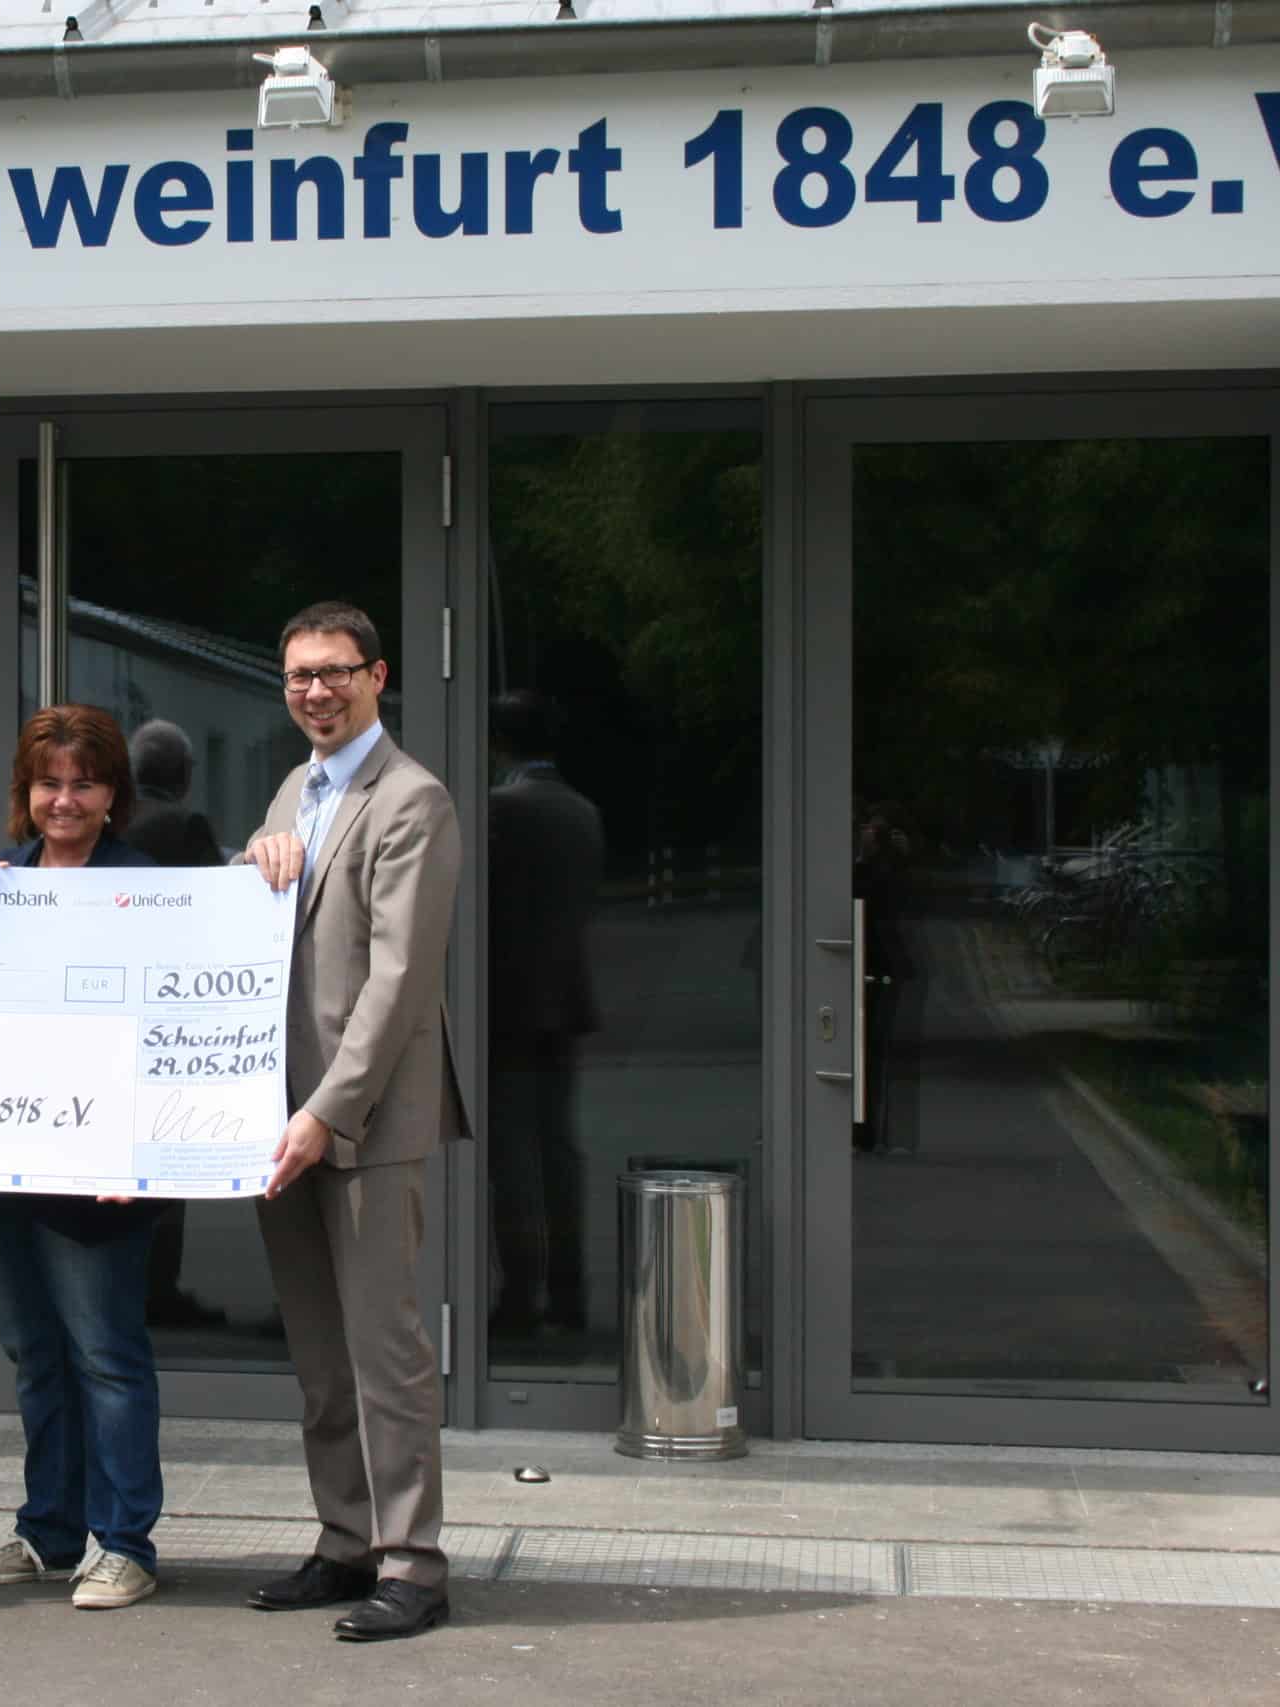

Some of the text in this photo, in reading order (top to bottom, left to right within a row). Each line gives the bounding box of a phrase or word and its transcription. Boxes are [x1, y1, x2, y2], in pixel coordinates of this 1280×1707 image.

[683, 100, 1049, 230] 1848
[1108, 91, 1280, 219] e.
[131, 893, 193, 908] UniCredit
[81, 977, 109, 991] EUR
[157, 968, 275, 999] 2.000,-
[143, 1023, 277, 1049] Schweinfurt
[148, 1047, 279, 1076] 29.05.2015
